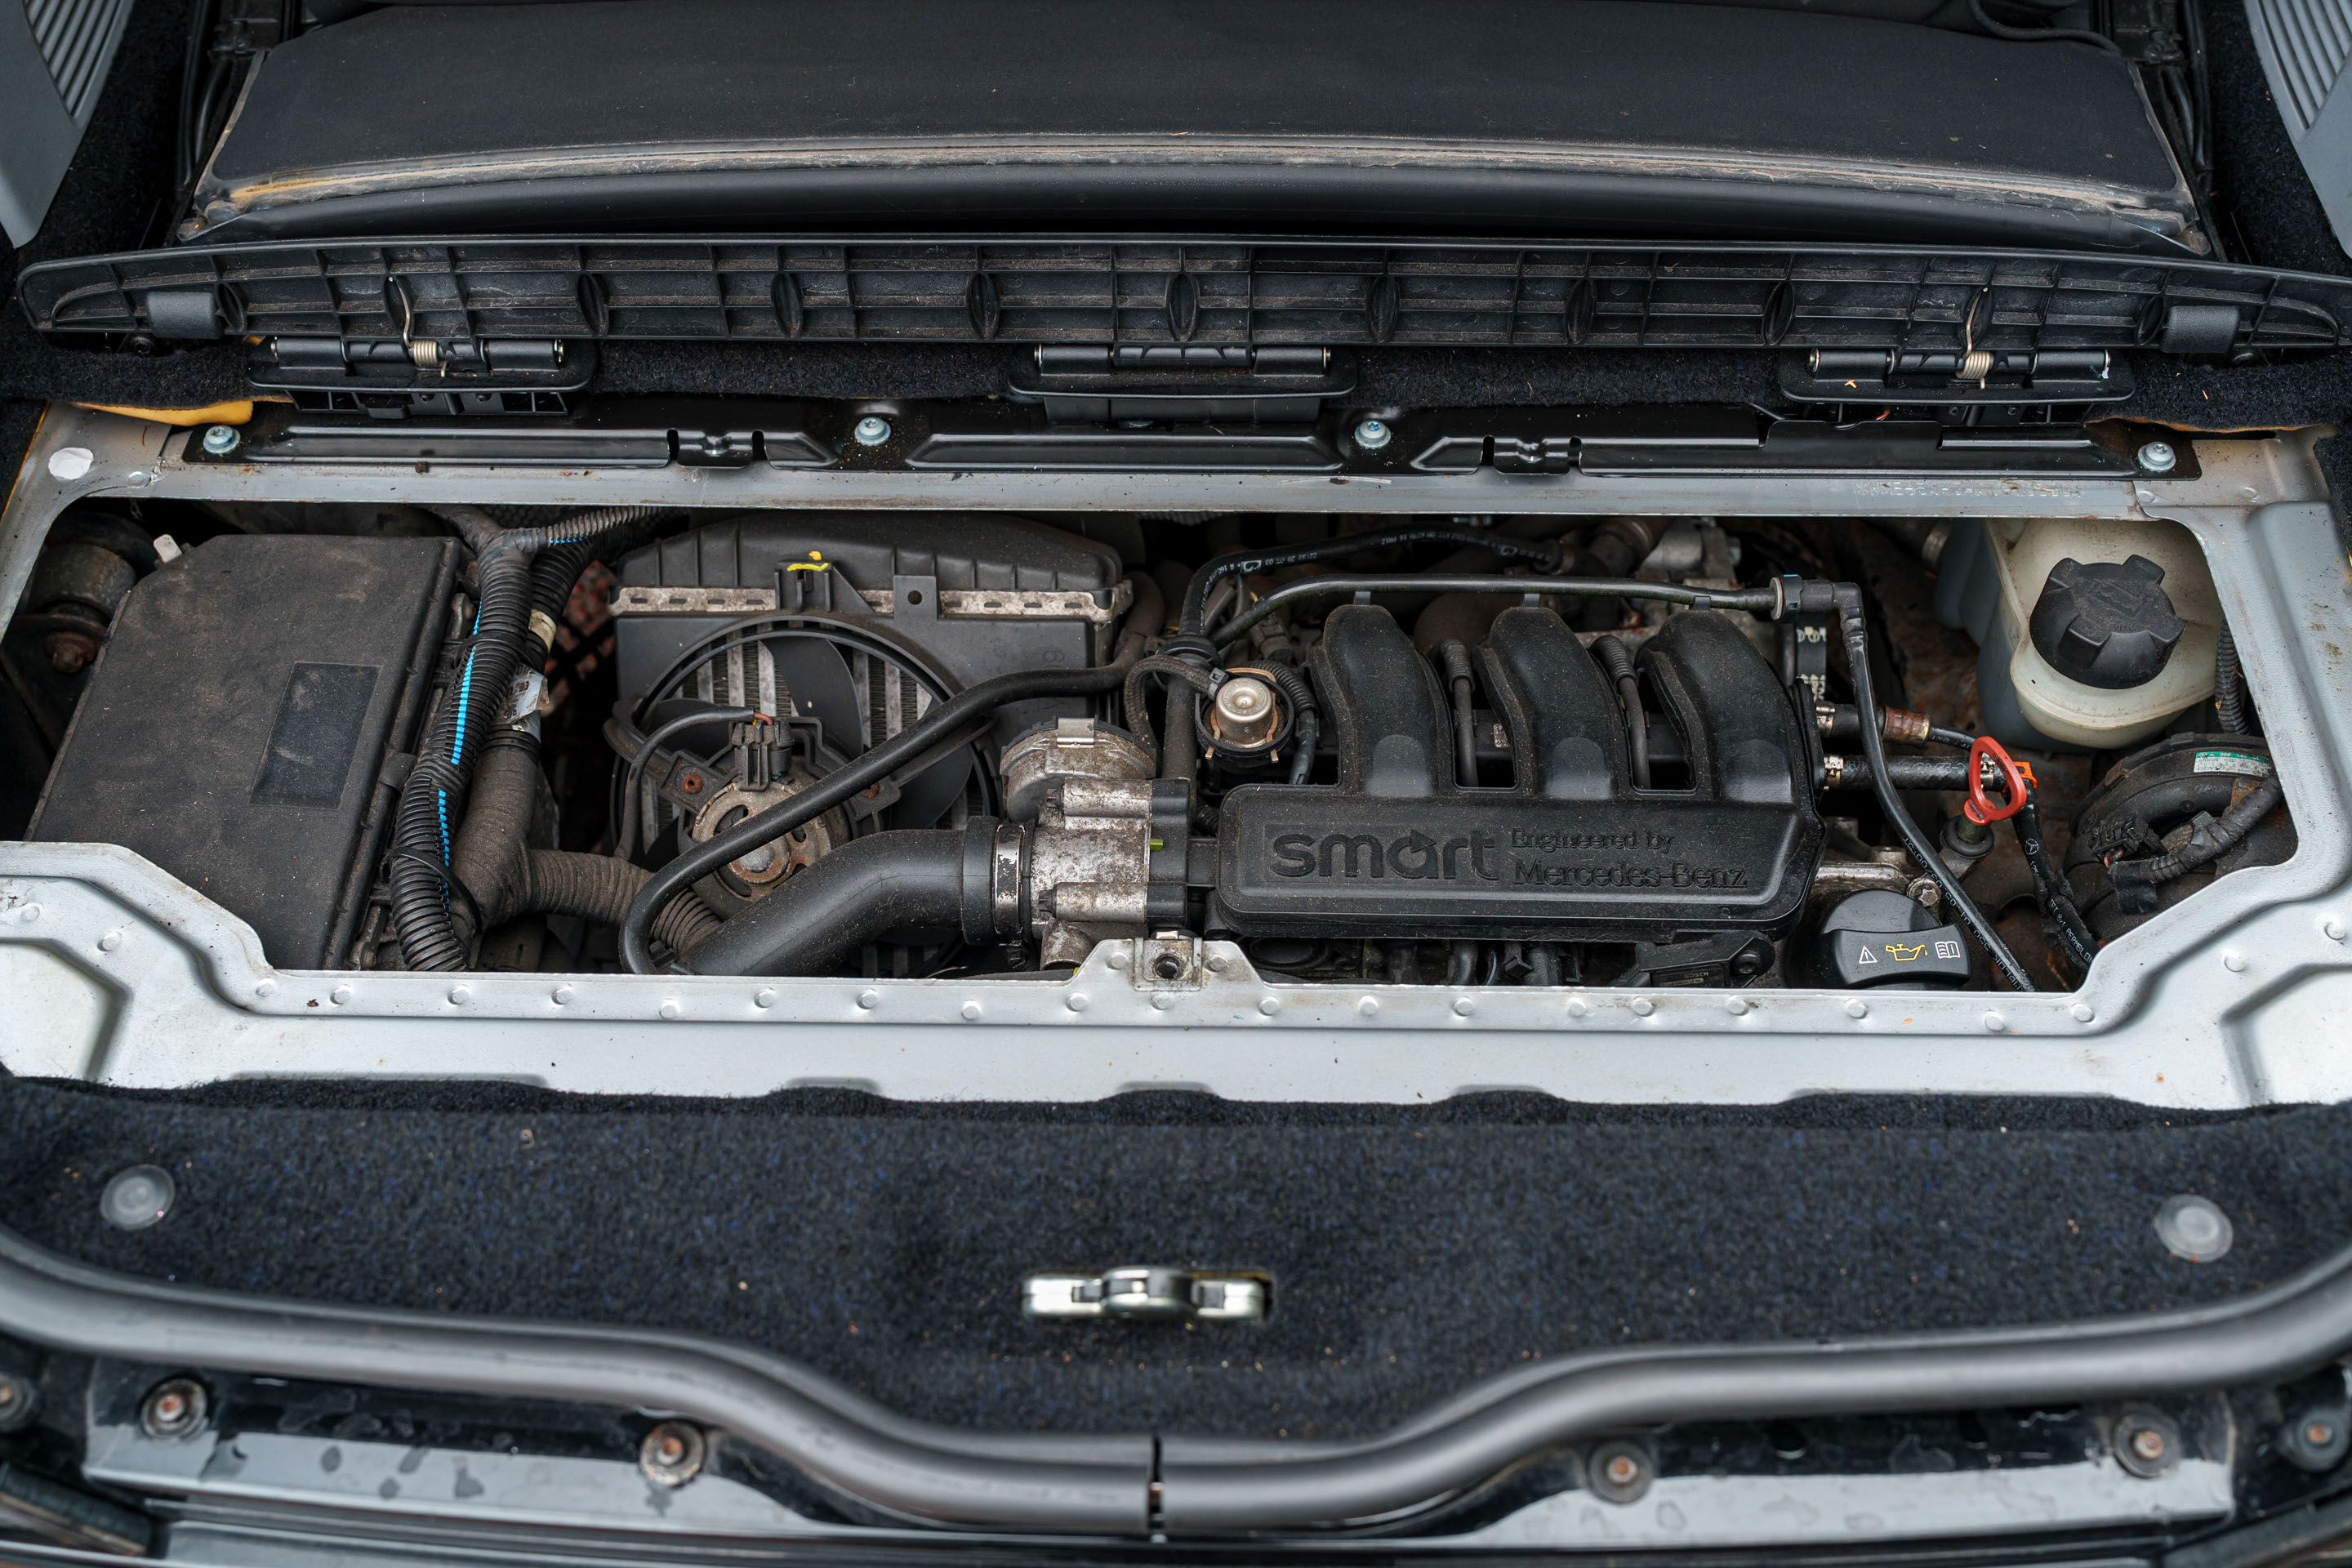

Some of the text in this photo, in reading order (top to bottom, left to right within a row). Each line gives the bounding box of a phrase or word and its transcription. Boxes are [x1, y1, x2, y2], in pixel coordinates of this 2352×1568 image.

[1270, 829, 1499, 880] smart
[1512, 827, 1675, 855] Engineered by
[1513, 858, 1748, 889] Mercedes-Benz
[1684, 971, 1709, 979] BOSCH
